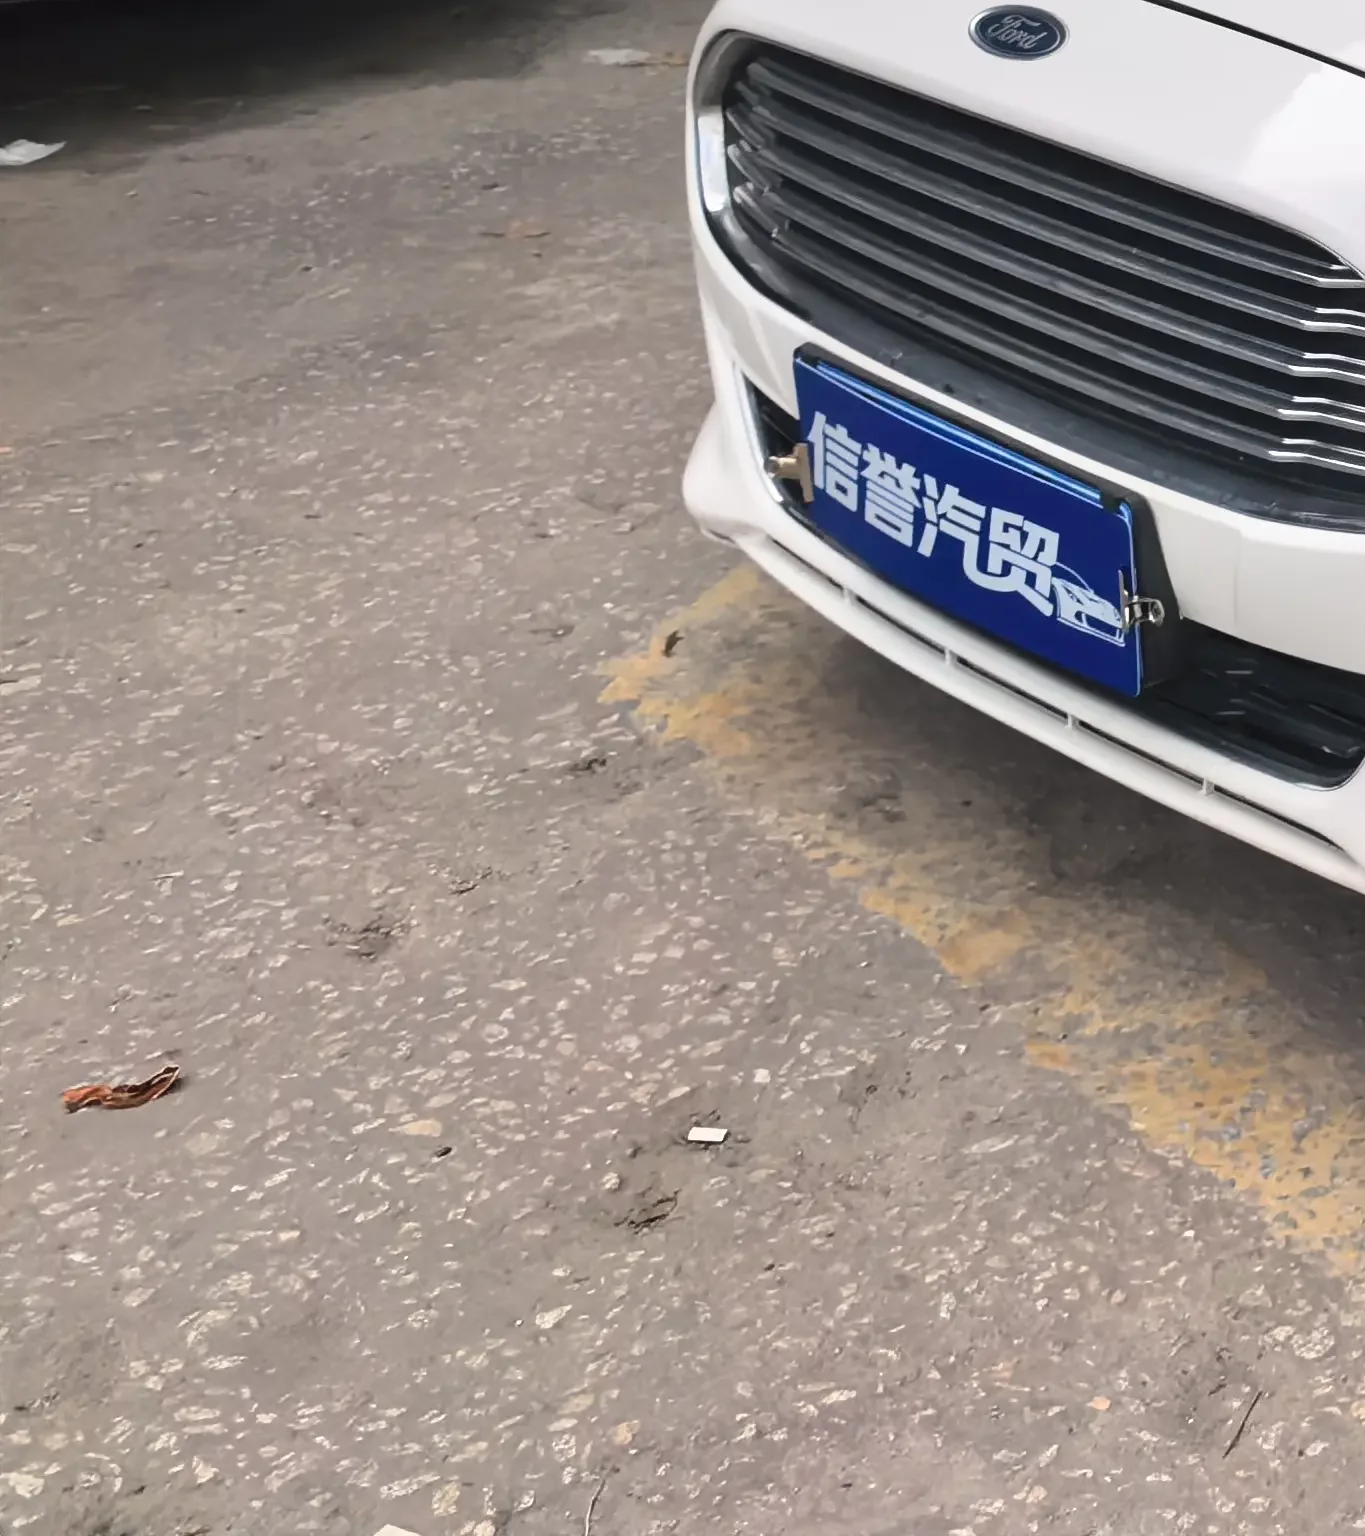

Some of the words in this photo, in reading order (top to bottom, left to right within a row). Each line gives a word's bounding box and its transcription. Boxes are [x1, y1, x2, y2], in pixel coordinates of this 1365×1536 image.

[985, 14, 1049, 50] Ford
[806, 410, 1060, 618] 信誉汽贸
